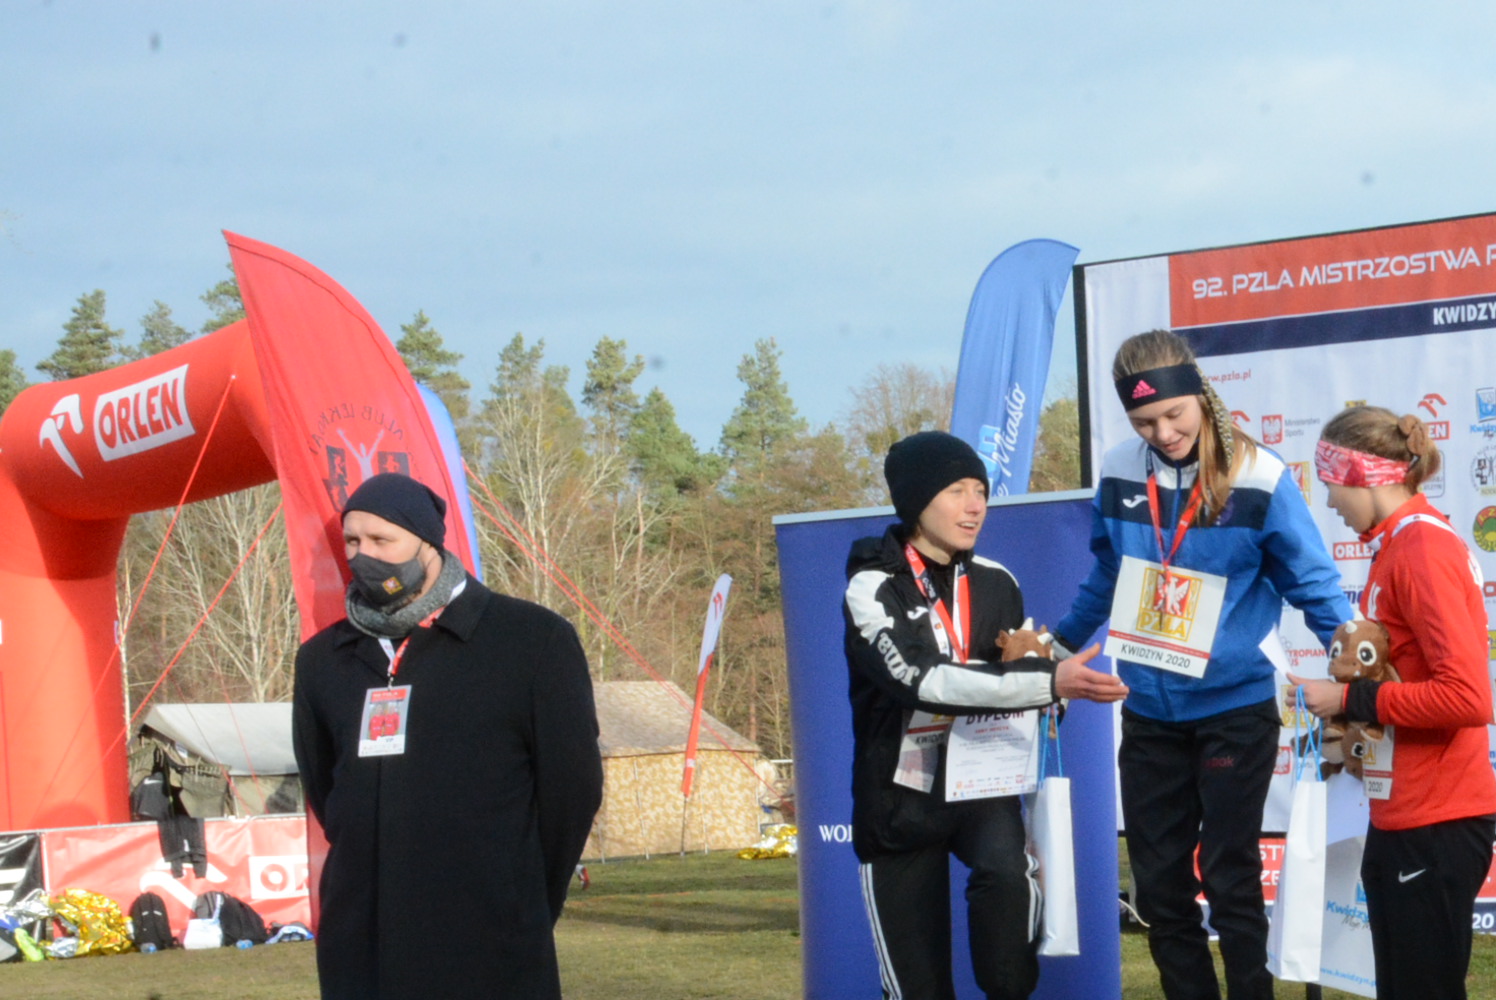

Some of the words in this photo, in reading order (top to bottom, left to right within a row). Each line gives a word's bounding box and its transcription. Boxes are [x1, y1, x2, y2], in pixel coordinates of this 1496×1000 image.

[1193, 277, 1228, 299] 92.
[1232, 269, 1294, 295] PZLA
[1300, 247, 1481, 288] MISTRZOSTWA
[98, 377, 185, 449] ORLEN
[1334, 543, 1375, 559] ORLE
[1121, 642, 1163, 662] KWIDZYN
[1164, 653, 1191, 670] 2020
[1326, 900, 1370, 924] Kwidzy
